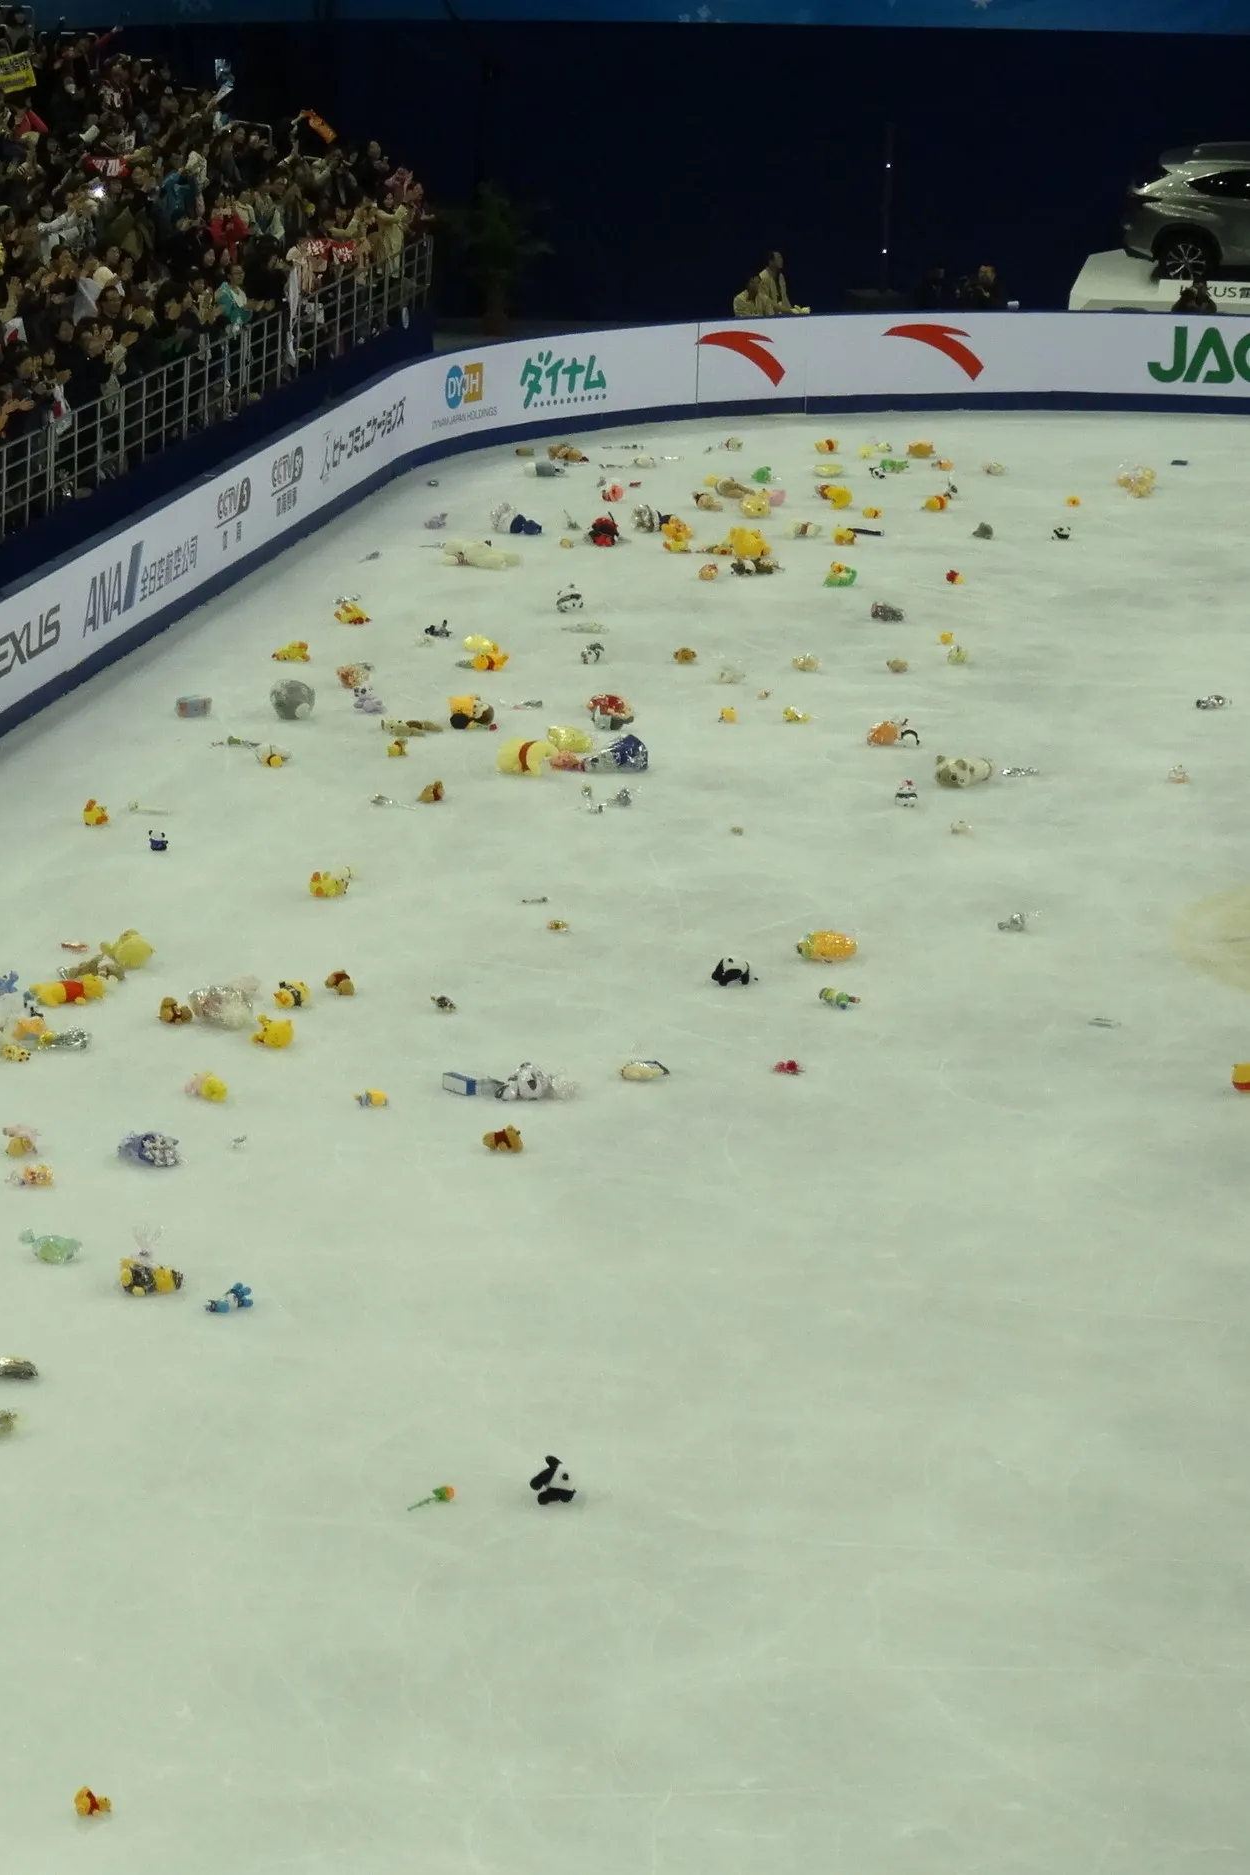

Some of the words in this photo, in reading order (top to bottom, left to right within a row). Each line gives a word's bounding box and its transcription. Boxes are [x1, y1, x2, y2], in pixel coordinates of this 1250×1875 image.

[520, 350, 607, 409] ダイナム
[467, 406, 498, 421] HOLDINGS
[82, 561, 122, 638] ANA
